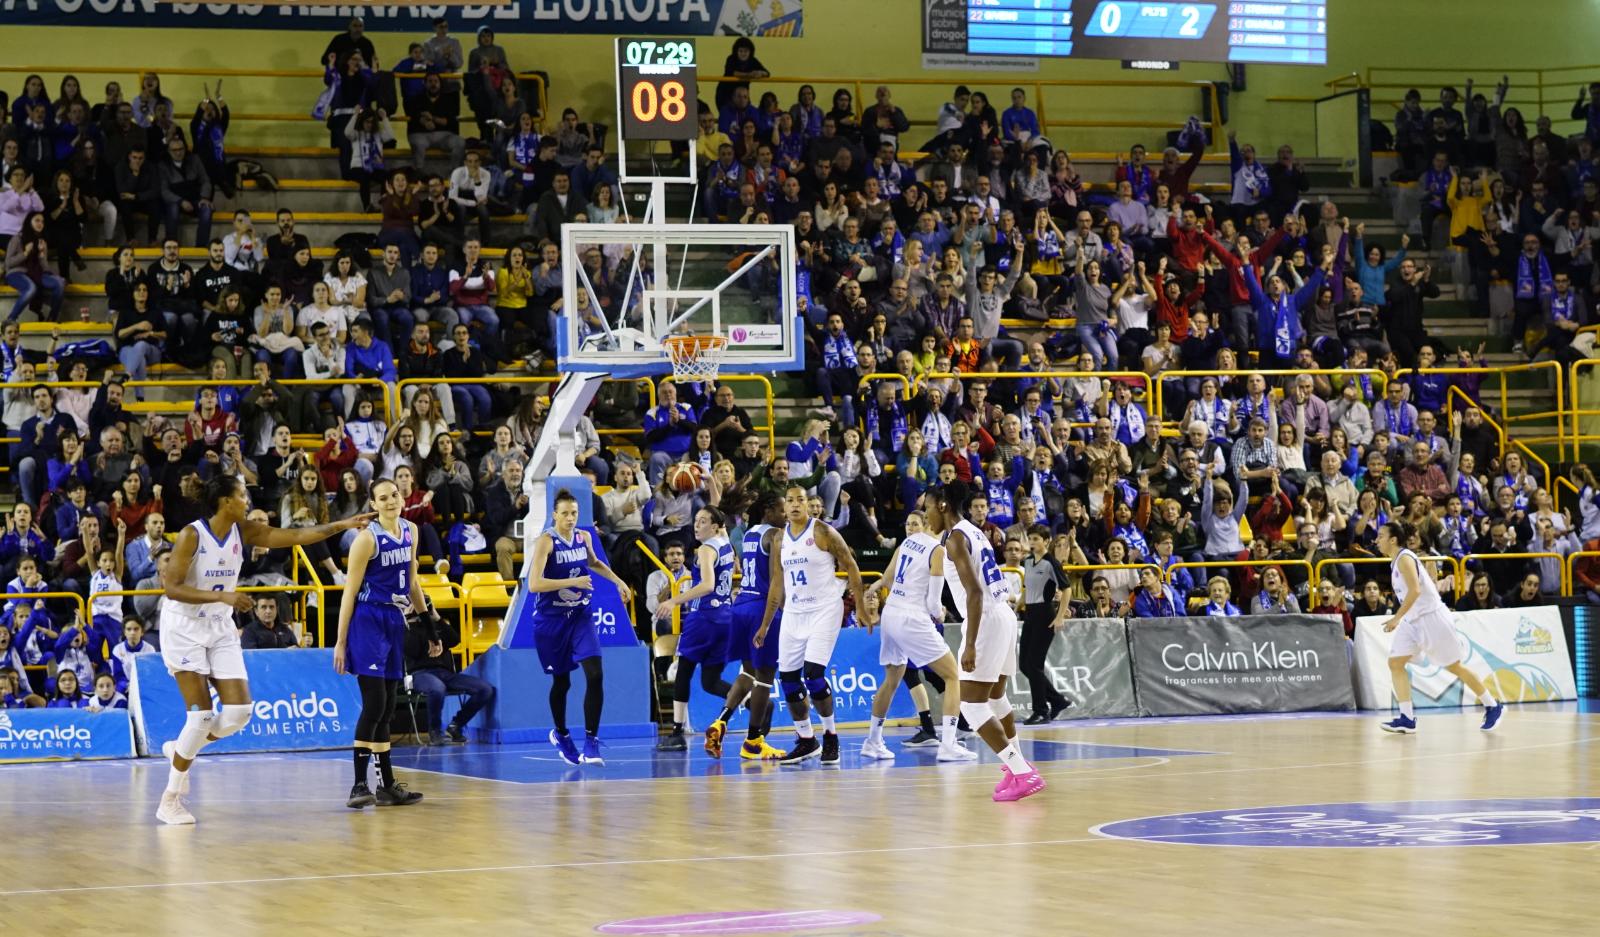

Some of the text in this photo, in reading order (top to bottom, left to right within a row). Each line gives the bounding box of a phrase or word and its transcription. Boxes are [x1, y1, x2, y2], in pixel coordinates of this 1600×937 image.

[969, 11, 983, 21] 22
[1100, 3, 1200, 36] 0 2
[626, 42, 694, 65] 07:29
[632, 81, 687, 122] 08
[205, 569, 236, 577] AVENIDA
[399, 569, 406, 589] 6
[790, 570, 808, 587] 14
[1161, 640, 1319, 672] Calvin Klein
[1164, 673, 1323, 687] fragrances for men and women
